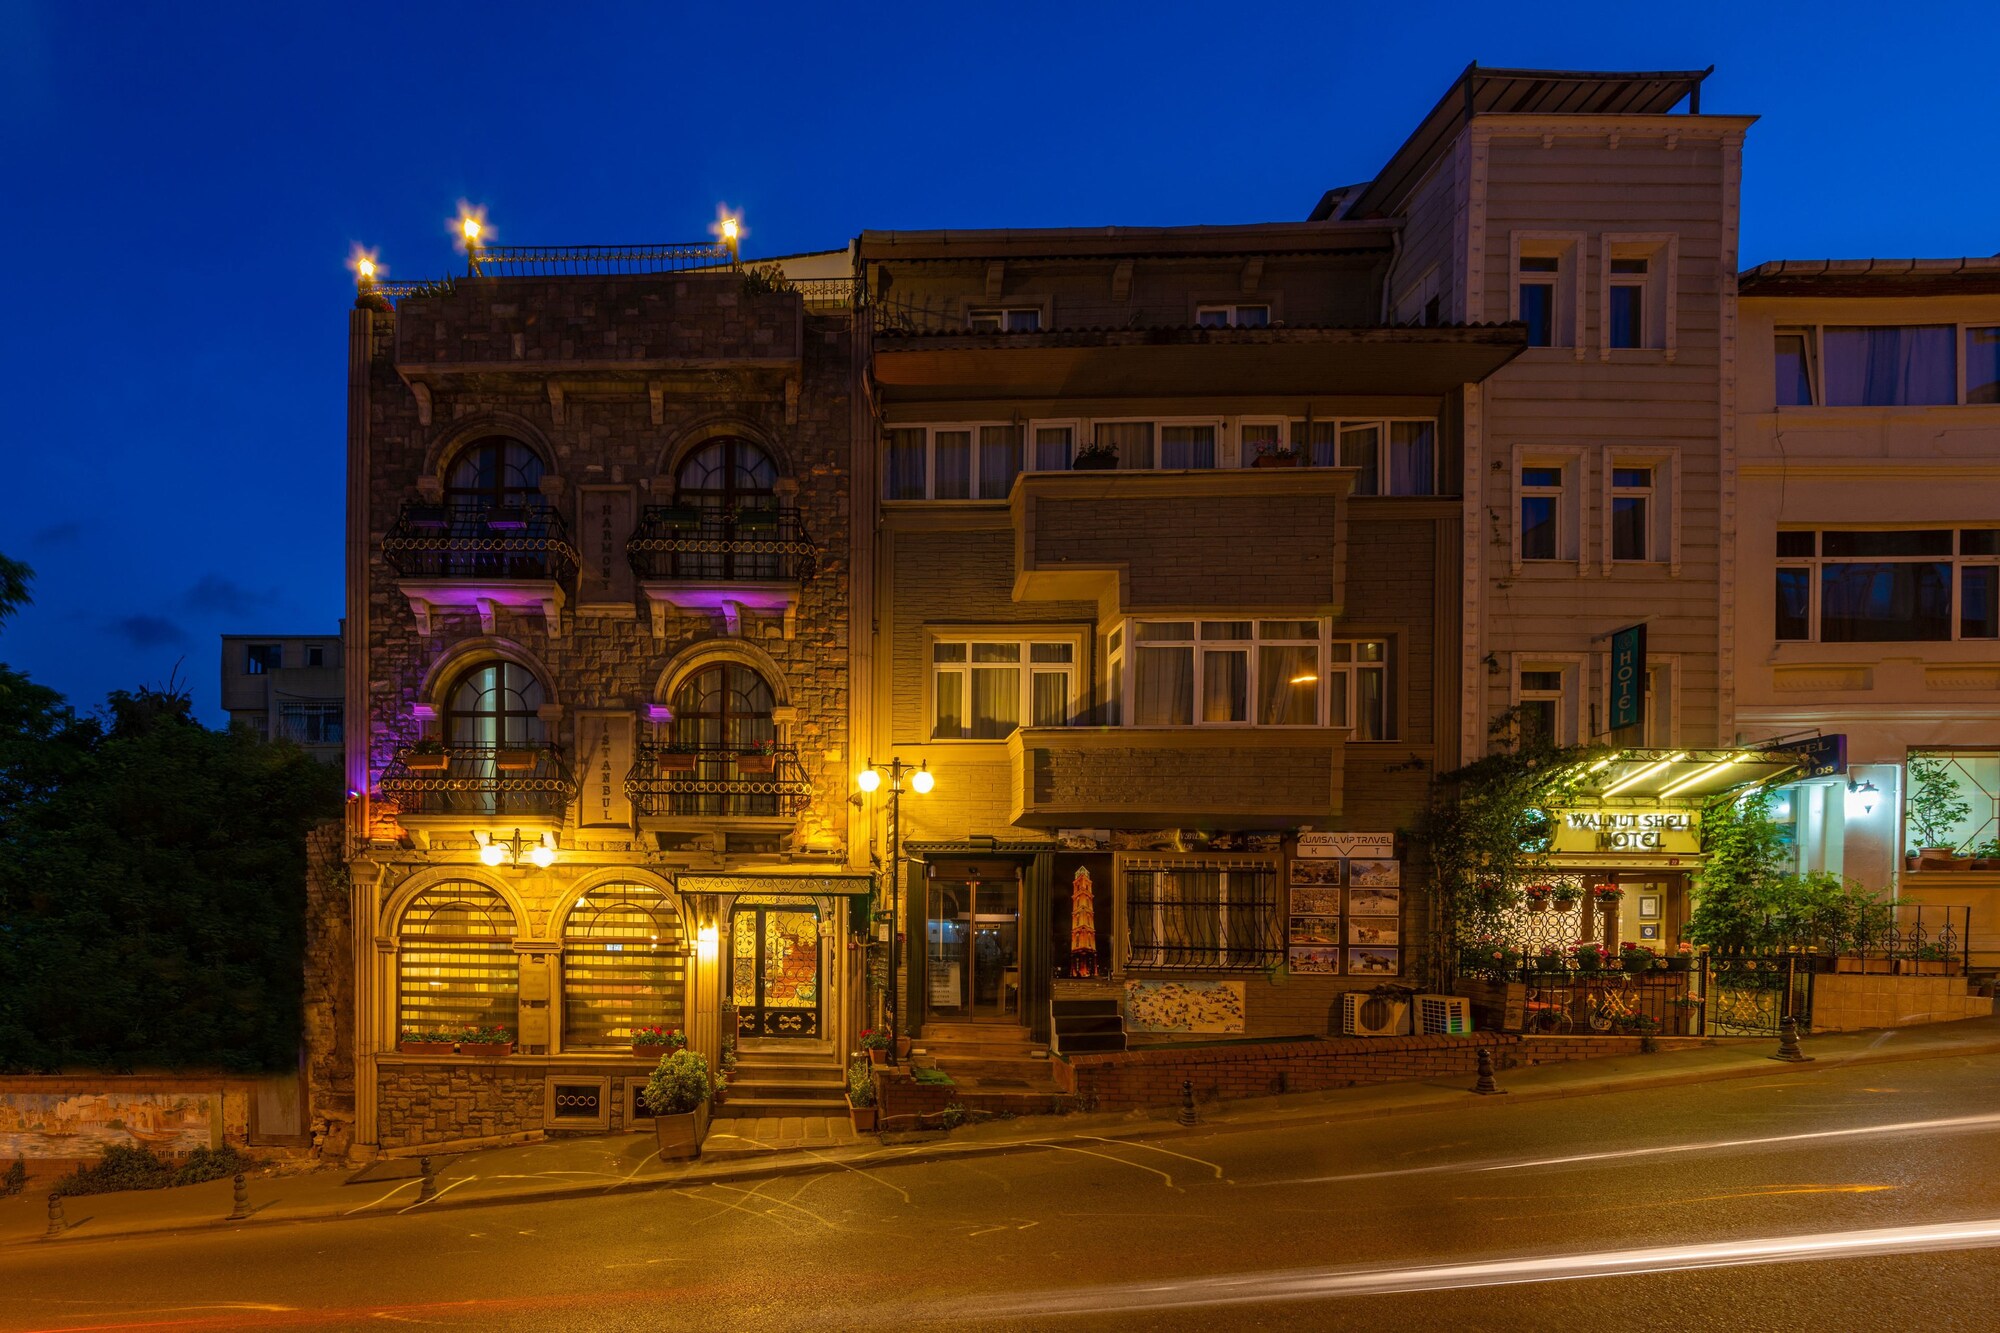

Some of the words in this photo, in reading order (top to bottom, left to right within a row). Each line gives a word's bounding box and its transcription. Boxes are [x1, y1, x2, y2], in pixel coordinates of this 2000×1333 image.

[602, 504, 612, 591] HARMONY
[1618, 650, 1633, 724] HOTEL
[1567, 814, 1640, 827] WALNUT
[1642, 814, 1696, 828] SHELL
[1357, 836, 1392, 844] TRAVEL
[1598, 832, 1667, 848] HOTEL
[1311, 847, 1318, 855] K
[1375, 847, 1380, 855] T
